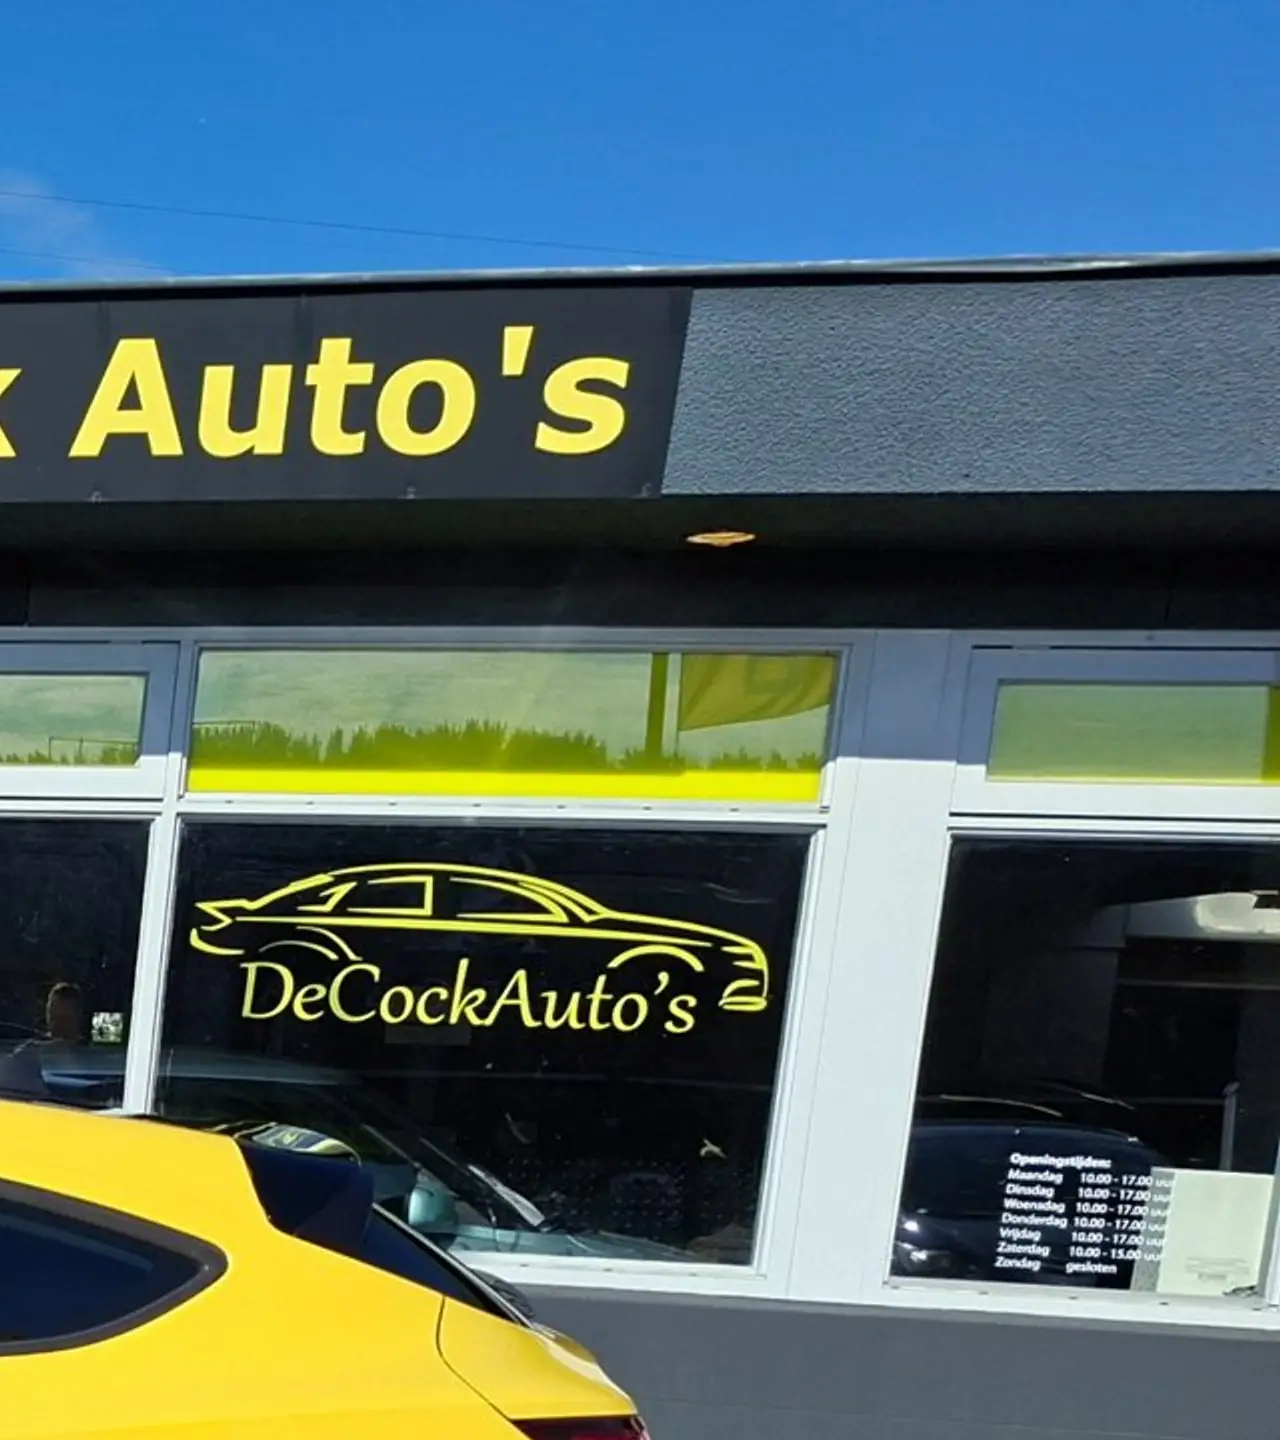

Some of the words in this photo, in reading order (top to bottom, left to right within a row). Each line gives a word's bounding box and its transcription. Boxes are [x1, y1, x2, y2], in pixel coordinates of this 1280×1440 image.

[69, 326, 629, 457] Auto's
[240, 957, 697, 1034] DeCockAuto's
[1010, 1152, 1112, 1170] Openingstijden:
[1008, 1168, 1063, 1184] Maandag
[1080, 1173, 1112, 1185] 10.00
[1122, 1175, 1153, 1187] 17.00
[1006, 1183, 1054, 1198] Dinsdag
[1078, 1188, 1109, 1199] 10.00
[1120, 1190, 1151, 1201] 17.00
[1004, 1198, 1065, 1213] Woensdag
[1076, 1202, 1107, 1213] 10.00
[1117, 1204, 1149, 1215] 17.00
[1002, 1212, 1068, 1228] Donderdag
[1074, 1217, 1105, 1229] 10.00
[1115, 1219, 1146, 1231] 17.00
[1000, 1227, 1041, 1242] Vrijdag
[1071, 1232, 1103, 1243] 10.00
[1113, 1234, 1144, 1245] 17.00
[997, 1241, 1051, 1256] Zaterdag
[1069, 1246, 1101, 1258] 10.00
[1110, 1248, 1141, 1260] 15.00
[995, 1256, 1041, 1271] Zondag
[1066, 1261, 1117, 1273] gesloten
